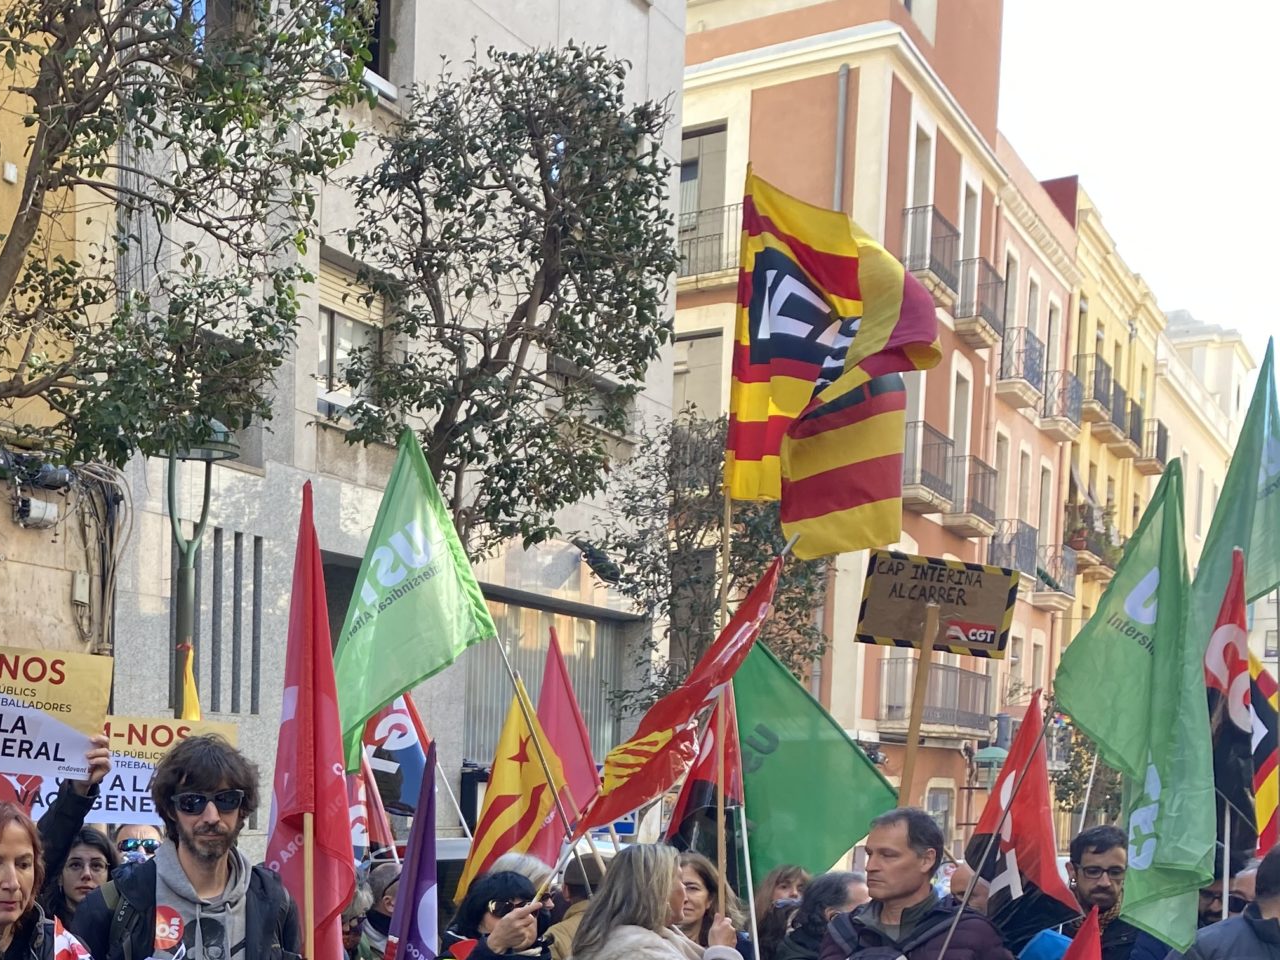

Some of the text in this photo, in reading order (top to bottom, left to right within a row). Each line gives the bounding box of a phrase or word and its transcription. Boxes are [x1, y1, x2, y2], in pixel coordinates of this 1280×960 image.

[876, 561, 983, 588] CAP INTERINA
[969, 629, 996, 643] CGT
[109, 774, 126, 791] A
